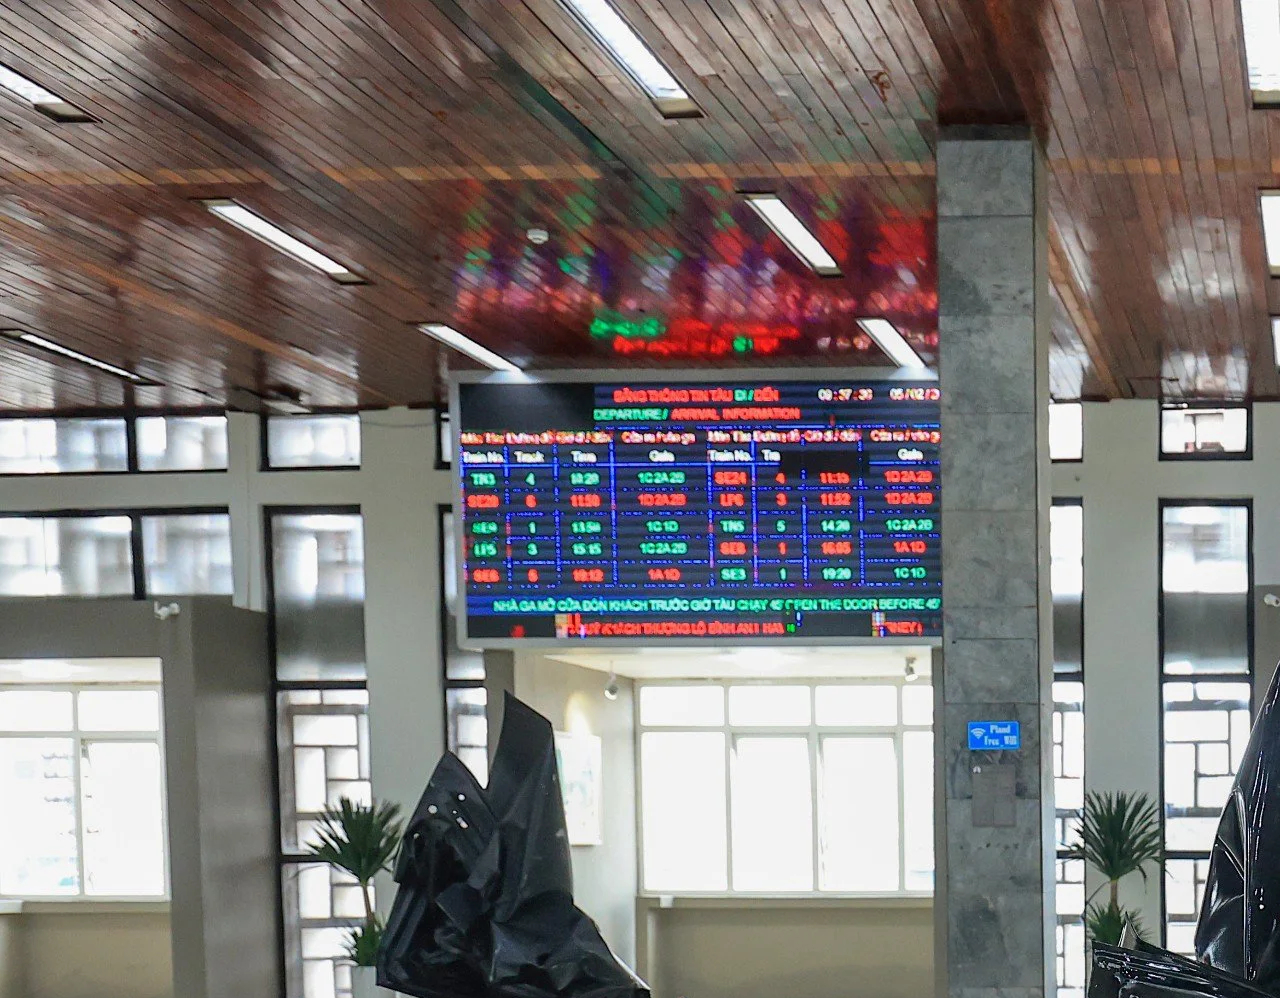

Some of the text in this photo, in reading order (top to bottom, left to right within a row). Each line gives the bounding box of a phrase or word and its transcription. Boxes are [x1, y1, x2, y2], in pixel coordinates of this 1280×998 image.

[671, 407, 720, 421] ARRIVAL
[722, 407, 801, 421] INFORMATION
[648, 450, 675, 462] Gate
[898, 448, 924, 461] Gate
[528, 521, 536, 534] 1
[778, 541, 787, 555] 1
[779, 567, 787, 580] 1
[493, 597, 519, 612] NHÀ
[519, 597, 537, 612] GA
[609, 597, 648, 612] KHÁCH
[648, 597, 689, 612] TRƯỚC
[712, 597, 735, 612] TÀU
[736, 597, 768, 612] CHẠY
[818, 597, 841, 612] THE
[843, 597, 879, 612] DOOR
[879, 597, 925, 612] BEFORE
